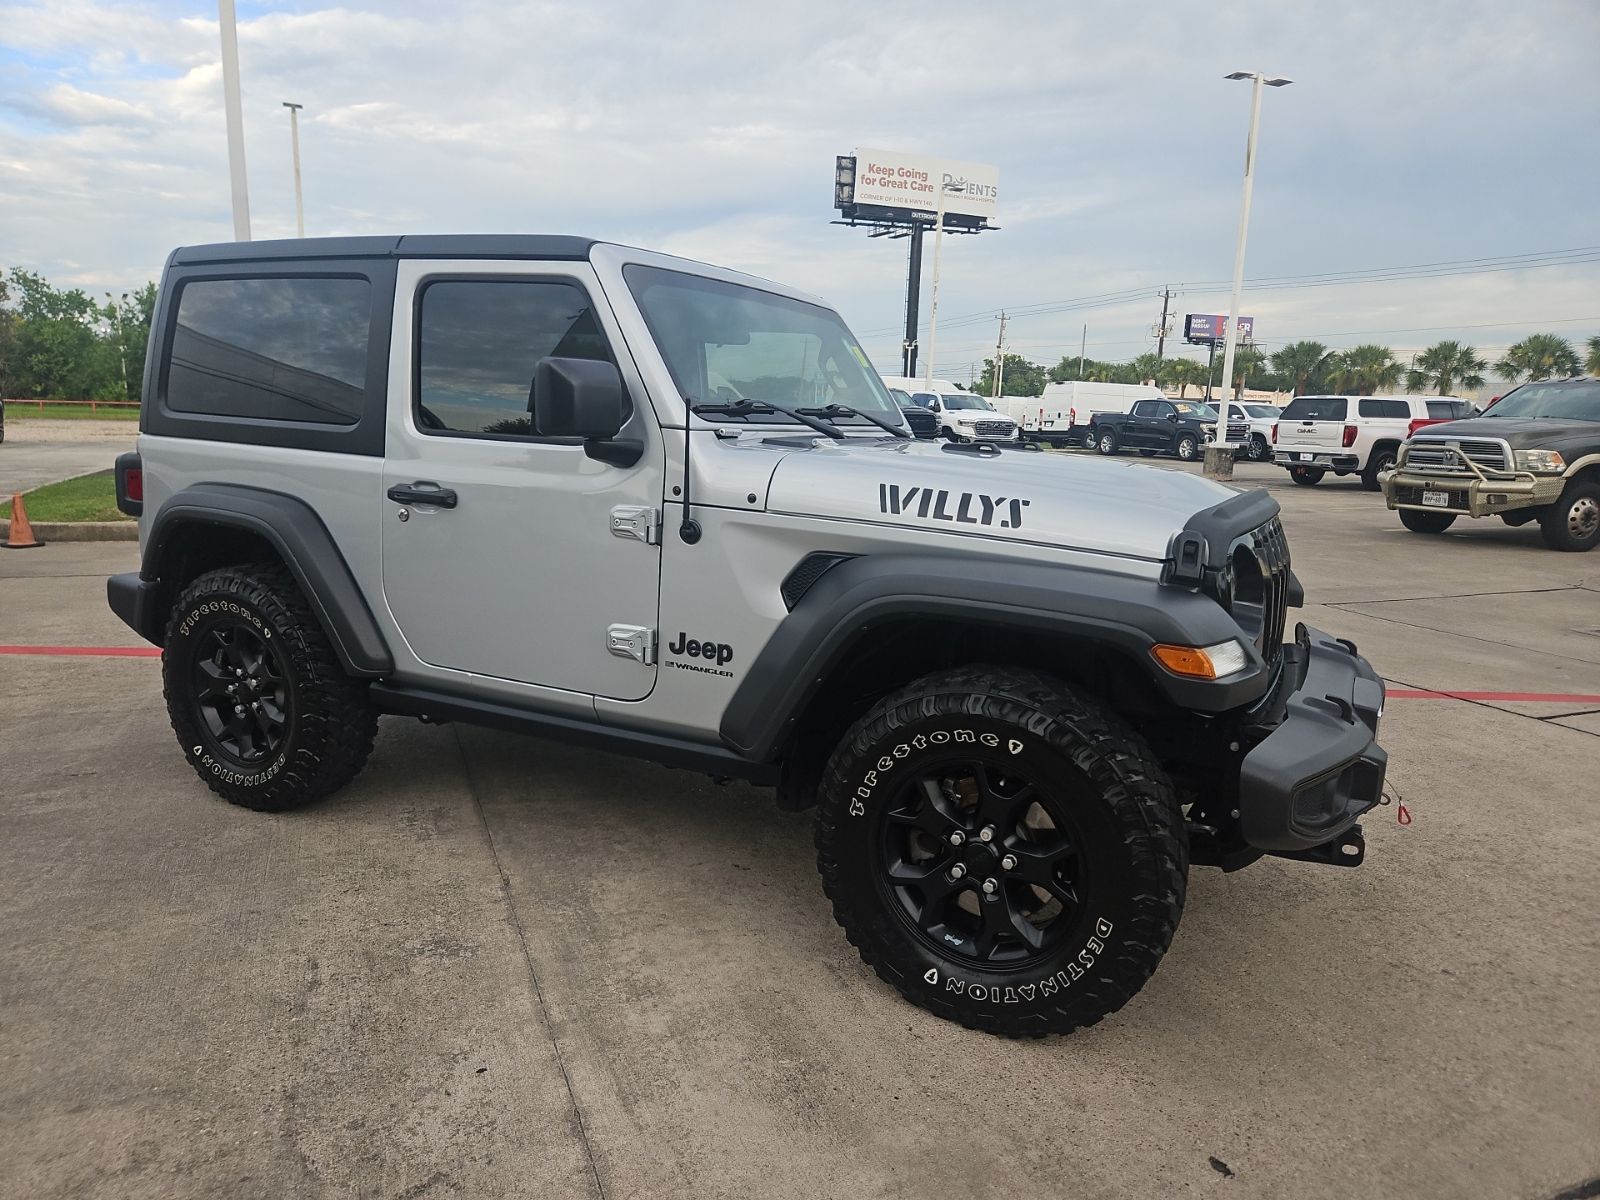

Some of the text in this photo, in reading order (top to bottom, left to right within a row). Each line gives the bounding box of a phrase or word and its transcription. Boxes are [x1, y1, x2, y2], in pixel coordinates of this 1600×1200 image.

[860, 174, 934, 192] for Great Care
[868, 163, 928, 182] Keep Going
[860, 192, 884, 201] CORNER
[879, 483, 1031, 529] WILLYS
[179, 600, 263, 637] Firestone
[668, 631, 734, 667] Jeep
[675, 661, 734, 678] WRANGLER
[201, 752, 287, 787] DESTINATION
[849, 729, 1000, 817] Firestone
[945, 916, 1114, 1004] DESTINATION
